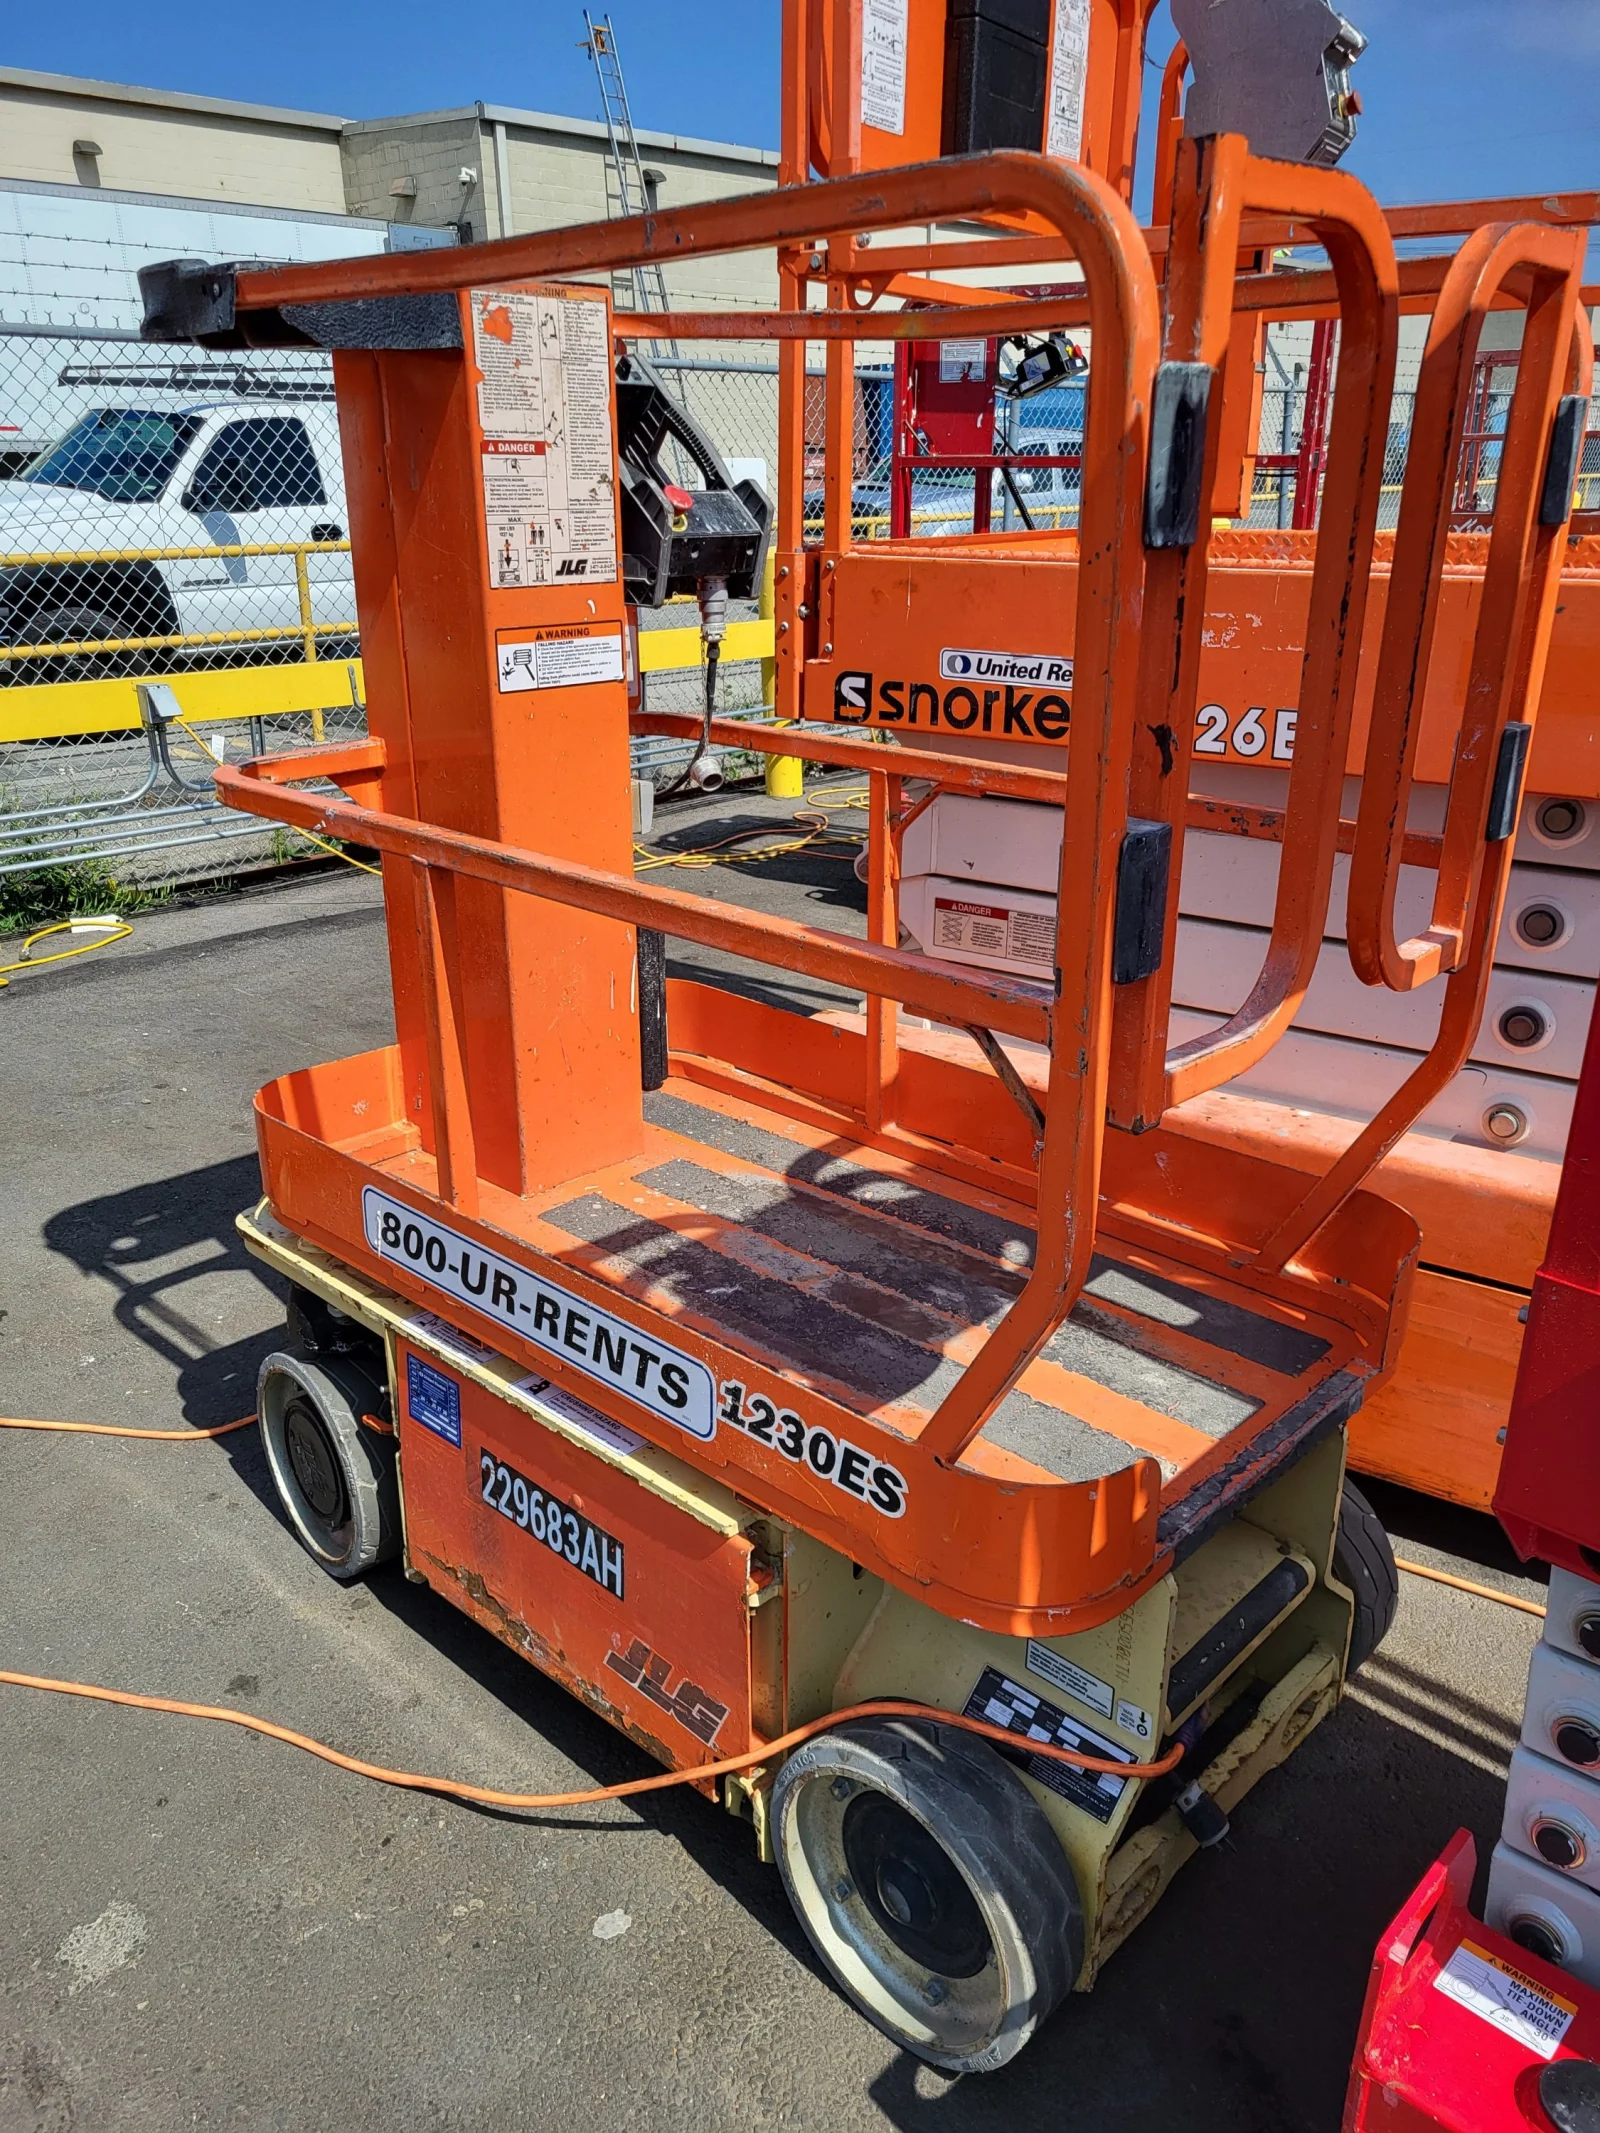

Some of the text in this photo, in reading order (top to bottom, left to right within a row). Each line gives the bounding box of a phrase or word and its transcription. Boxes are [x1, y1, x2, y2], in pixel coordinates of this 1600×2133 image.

[498, 443, 535, 452] DANGER
[555, 559, 588, 576] JLG
[545, 628, 590, 639] WARNING
[976, 658, 1073, 682] United Re
[878, 680, 1070, 740] snorke
[958, 903, 992, 916] DANGER
[381, 1212, 690, 1408] 800-UR-RENTS
[560, 1394, 620, 1430] CRUSHING HAZARD
[720, 1384, 906, 1514] 1230ES
[481, 1454, 623, 1596] 229683AH
[603, 1637, 730, 1746] JLG
[1502, 1962, 1555, 2000] WARNING
[1507, 1988, 1564, 2028] TIE-DOWN
[1510, 1980, 1568, 2020] MAXIMUM
[1520, 2010, 1560, 2037] ANGLE
[1534, 2028, 1554, 2041] 30°
